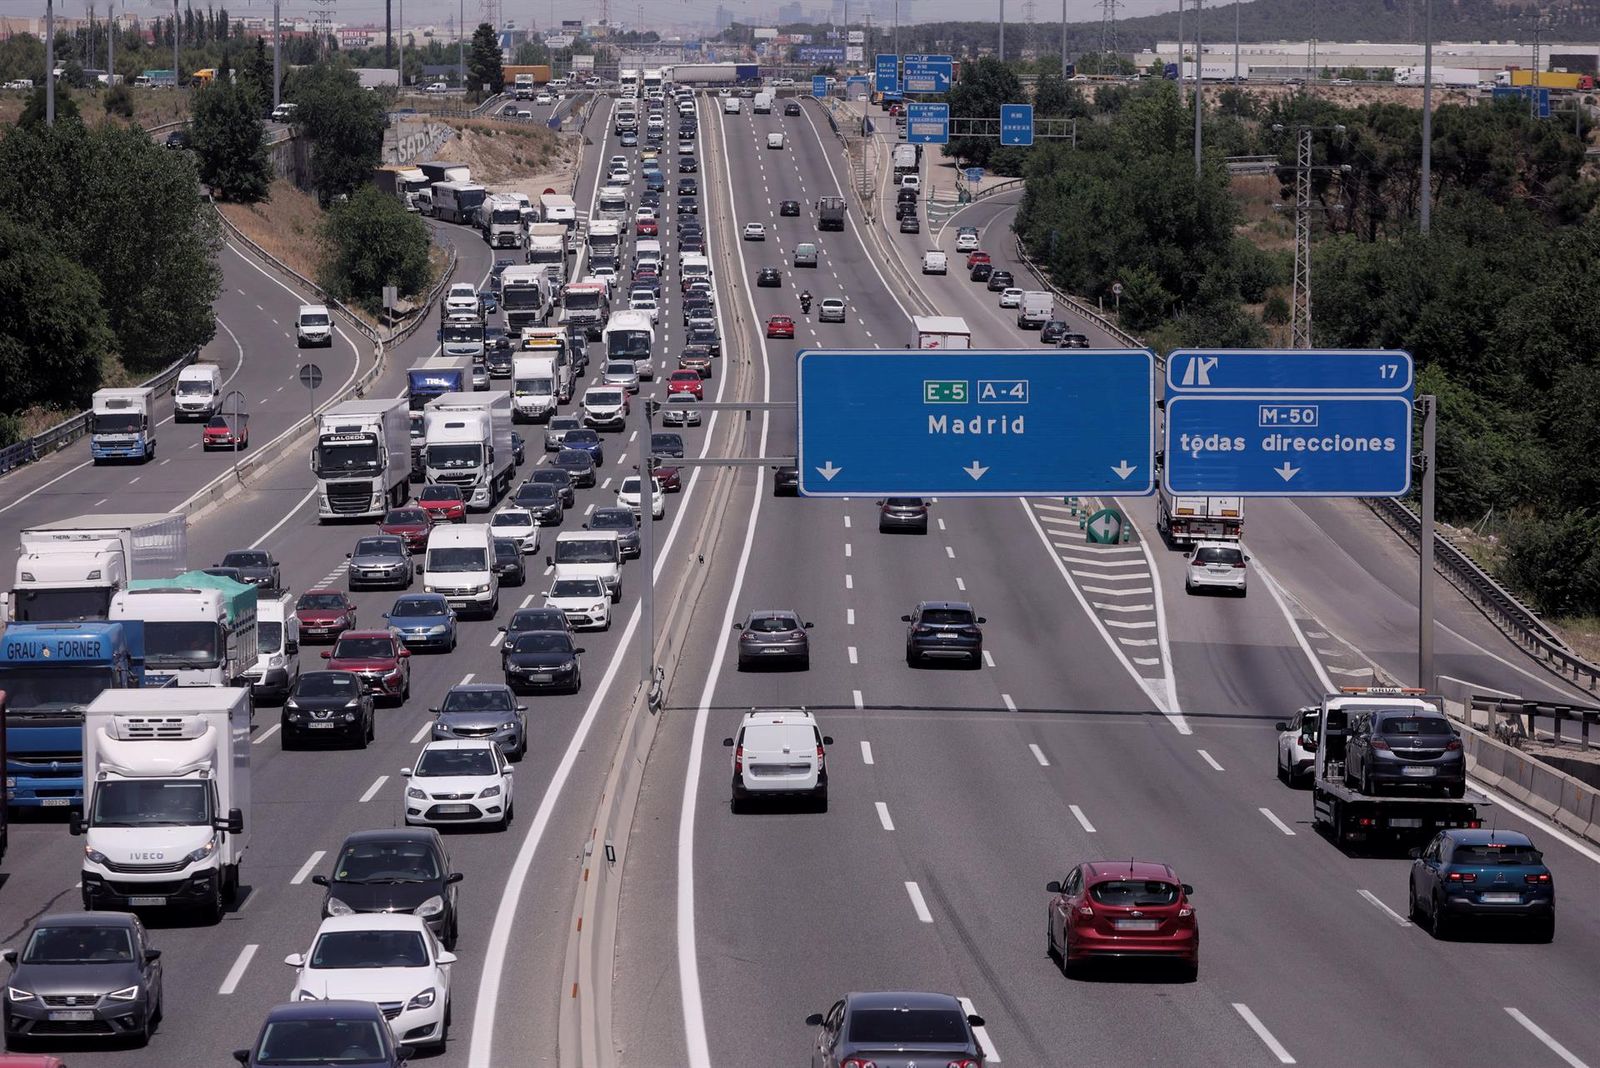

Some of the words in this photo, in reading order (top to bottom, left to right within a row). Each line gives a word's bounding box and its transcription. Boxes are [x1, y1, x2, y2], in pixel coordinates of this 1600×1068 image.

[1379, 364, 1398, 379] 17
[926, 382, 967, 401] E-5
[980, 382, 1027, 401] A-4
[928, 414, 1025, 435] Madrid
[1261, 407, 1316, 425] M-50
[1180, 433, 1246, 452] todas
[1262, 433, 1396, 452] direcciones
[7, 641, 37, 660] GRAU
[57, 640, 102, 659] FORNER
[129, 852, 164, 860] IVECO
